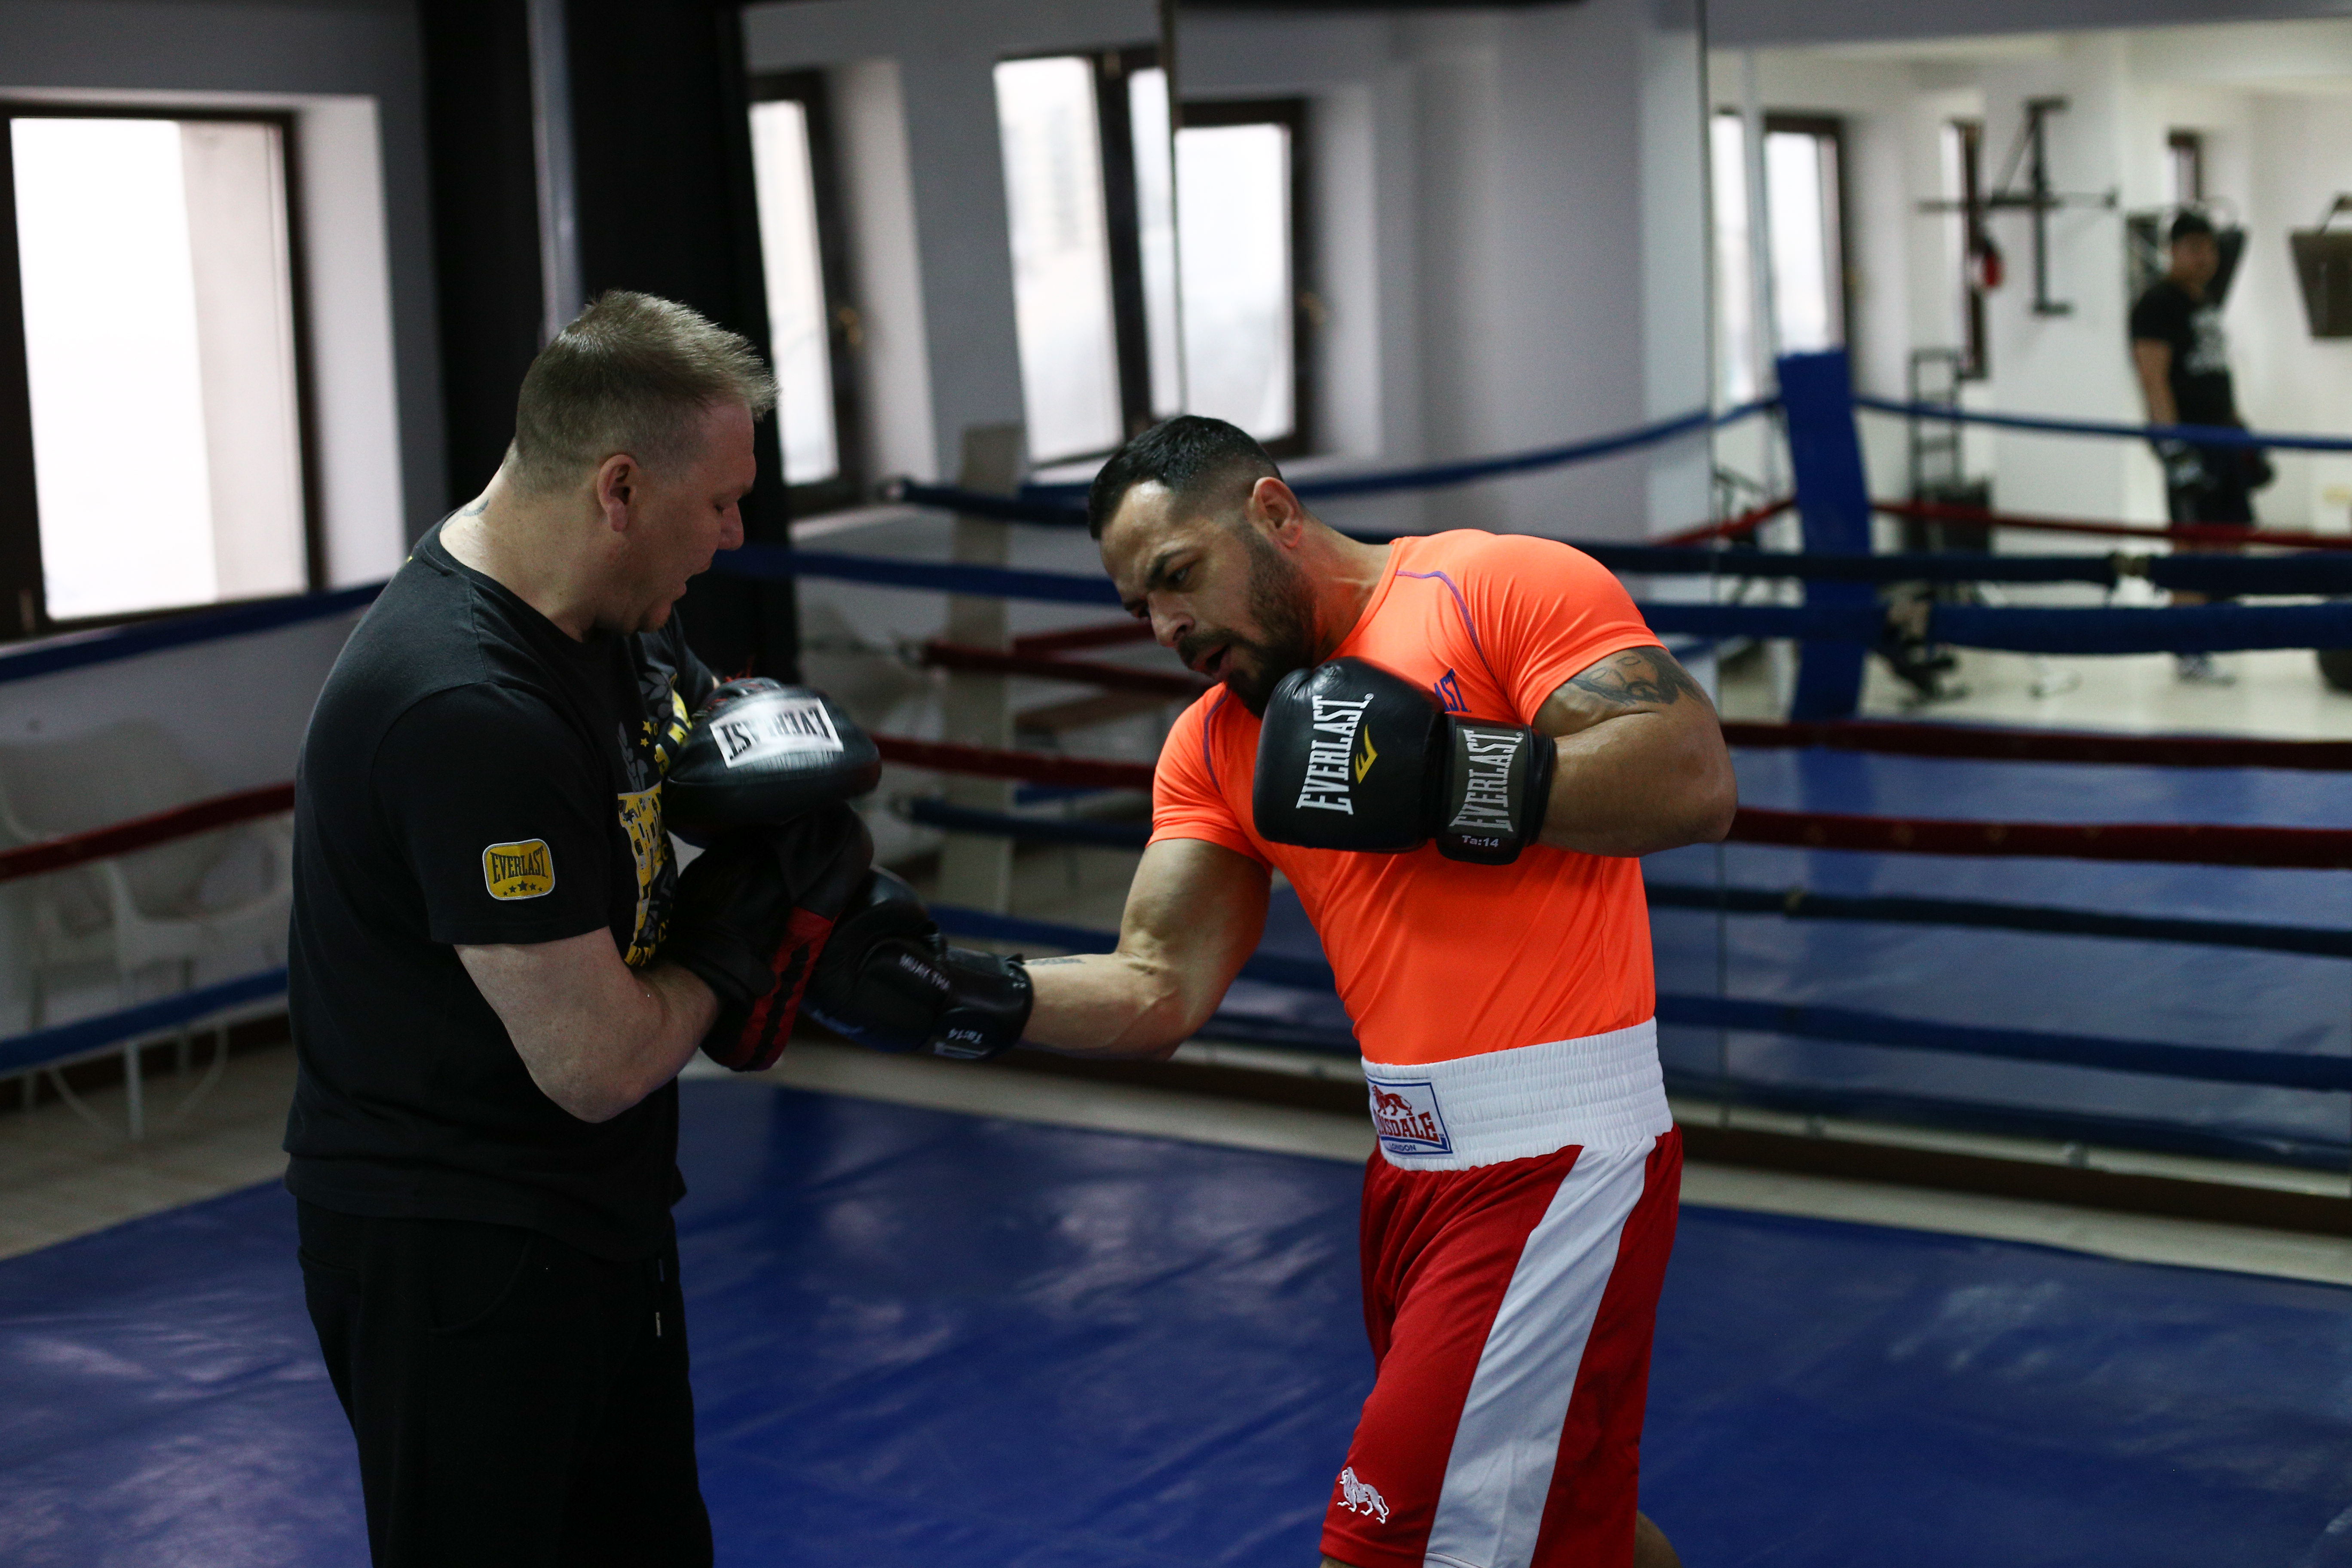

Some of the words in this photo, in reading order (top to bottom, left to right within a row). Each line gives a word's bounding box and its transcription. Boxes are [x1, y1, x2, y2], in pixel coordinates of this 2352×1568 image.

[1296, 695, 1370, 815] EVERLAST
[1449, 729, 1523, 832] EVERLAST
[1462, 835, 1499, 848] Ta:14
[490, 845, 546, 884] EVERLAST
[1376, 1112, 1440, 1142] NSDALE
